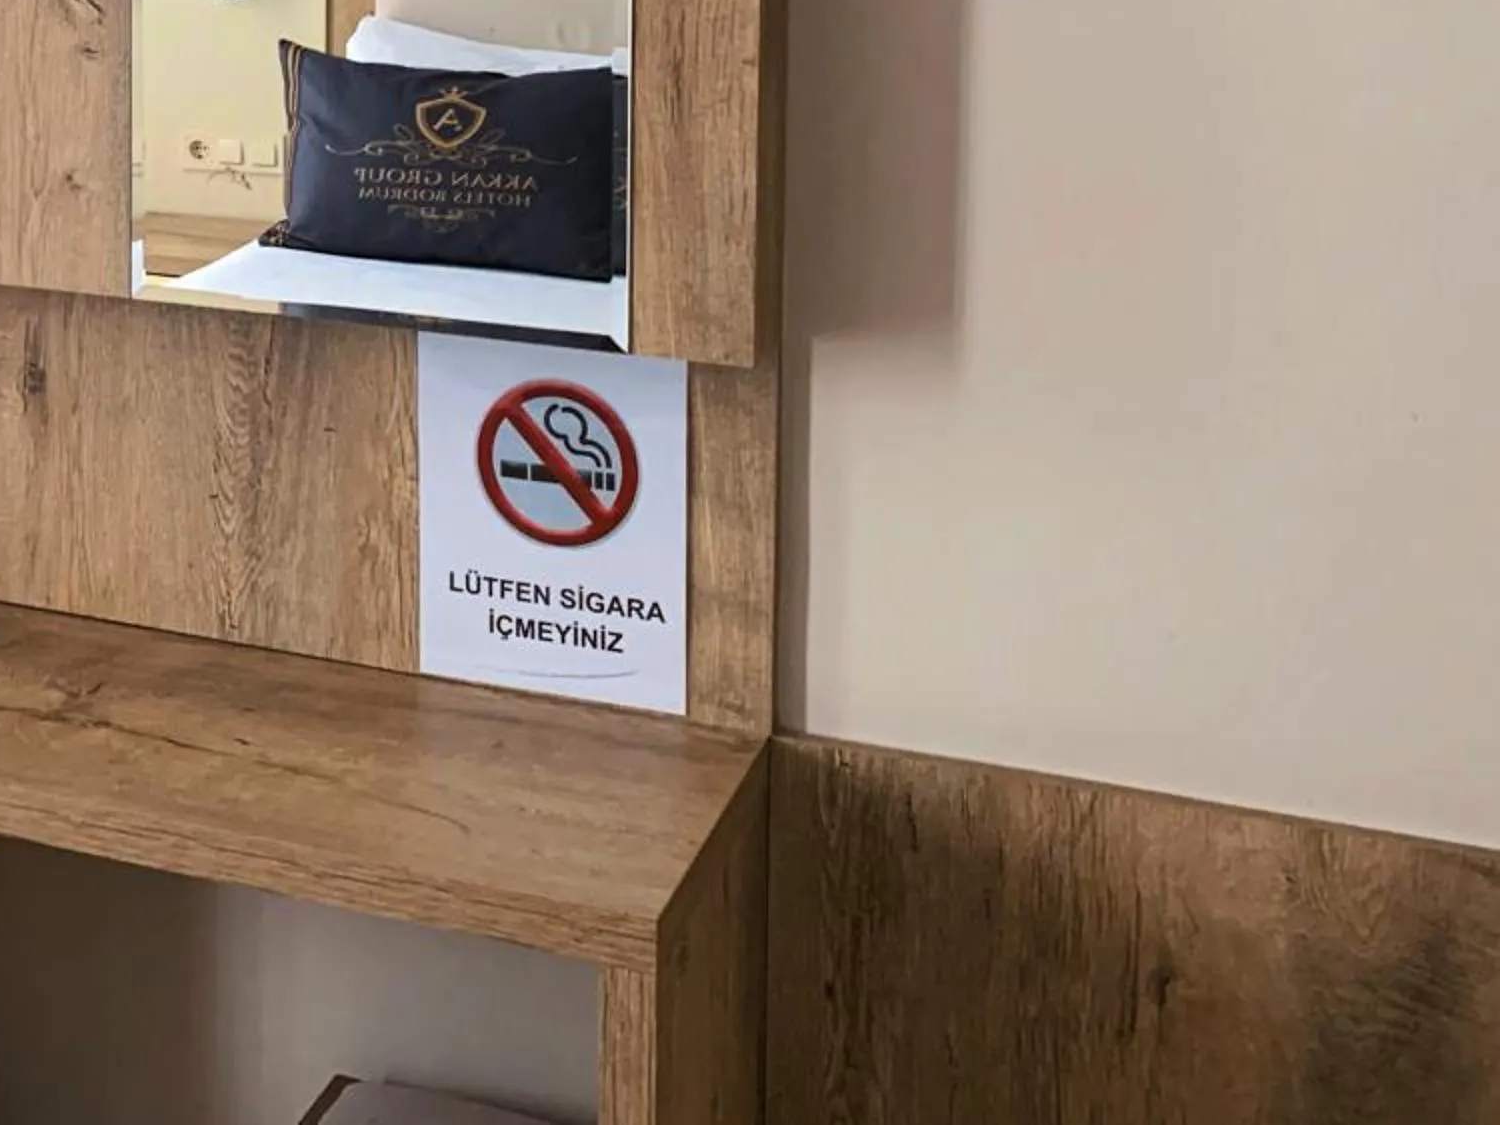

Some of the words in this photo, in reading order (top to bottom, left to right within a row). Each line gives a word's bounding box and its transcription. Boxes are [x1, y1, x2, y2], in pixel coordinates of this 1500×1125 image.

[449, 569, 551, 606] LÜTFEN
[559, 585, 666, 623] SİGARA
[488, 608, 624, 653] İÇMEYİNİZ
